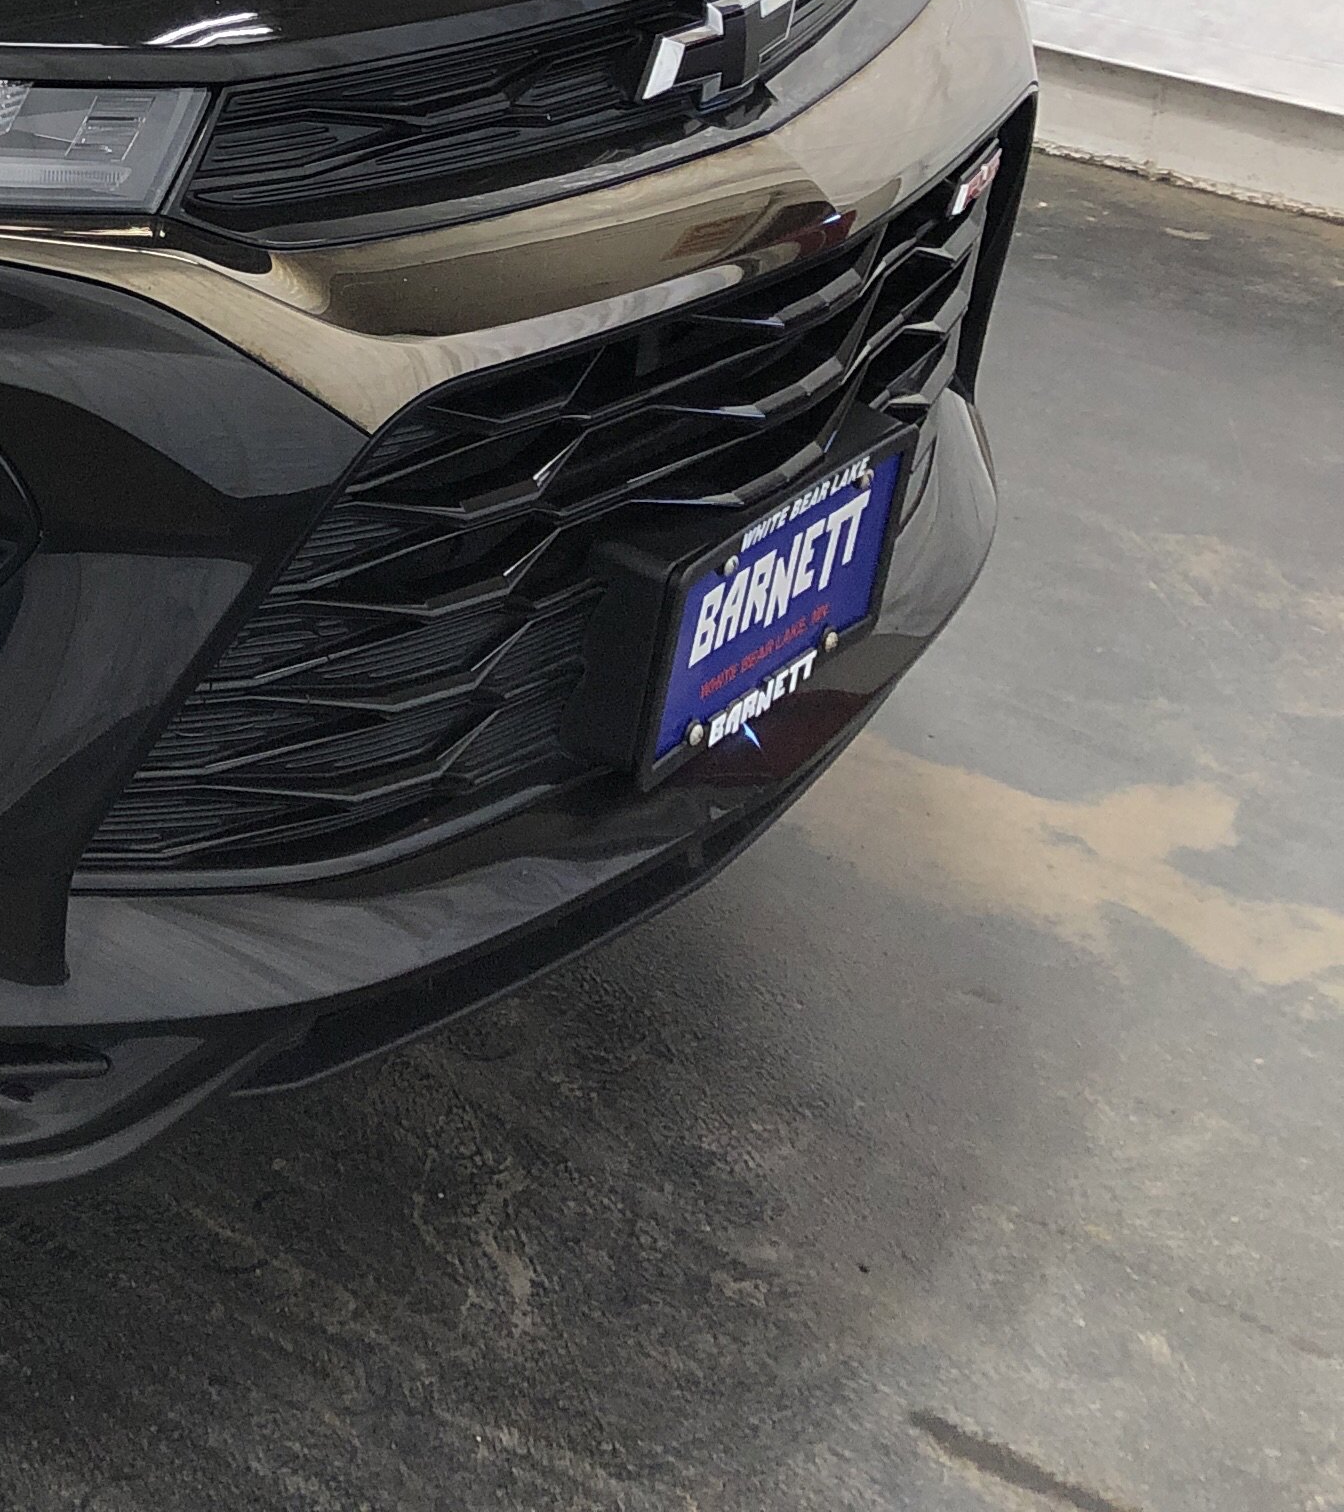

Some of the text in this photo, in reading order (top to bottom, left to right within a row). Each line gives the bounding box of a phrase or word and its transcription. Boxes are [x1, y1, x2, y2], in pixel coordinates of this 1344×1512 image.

[741, 455, 870, 552] WHITE BEAR LAKE
[688, 488, 872, 669] BARNETT
[708, 649, 818, 749] BARNETT
